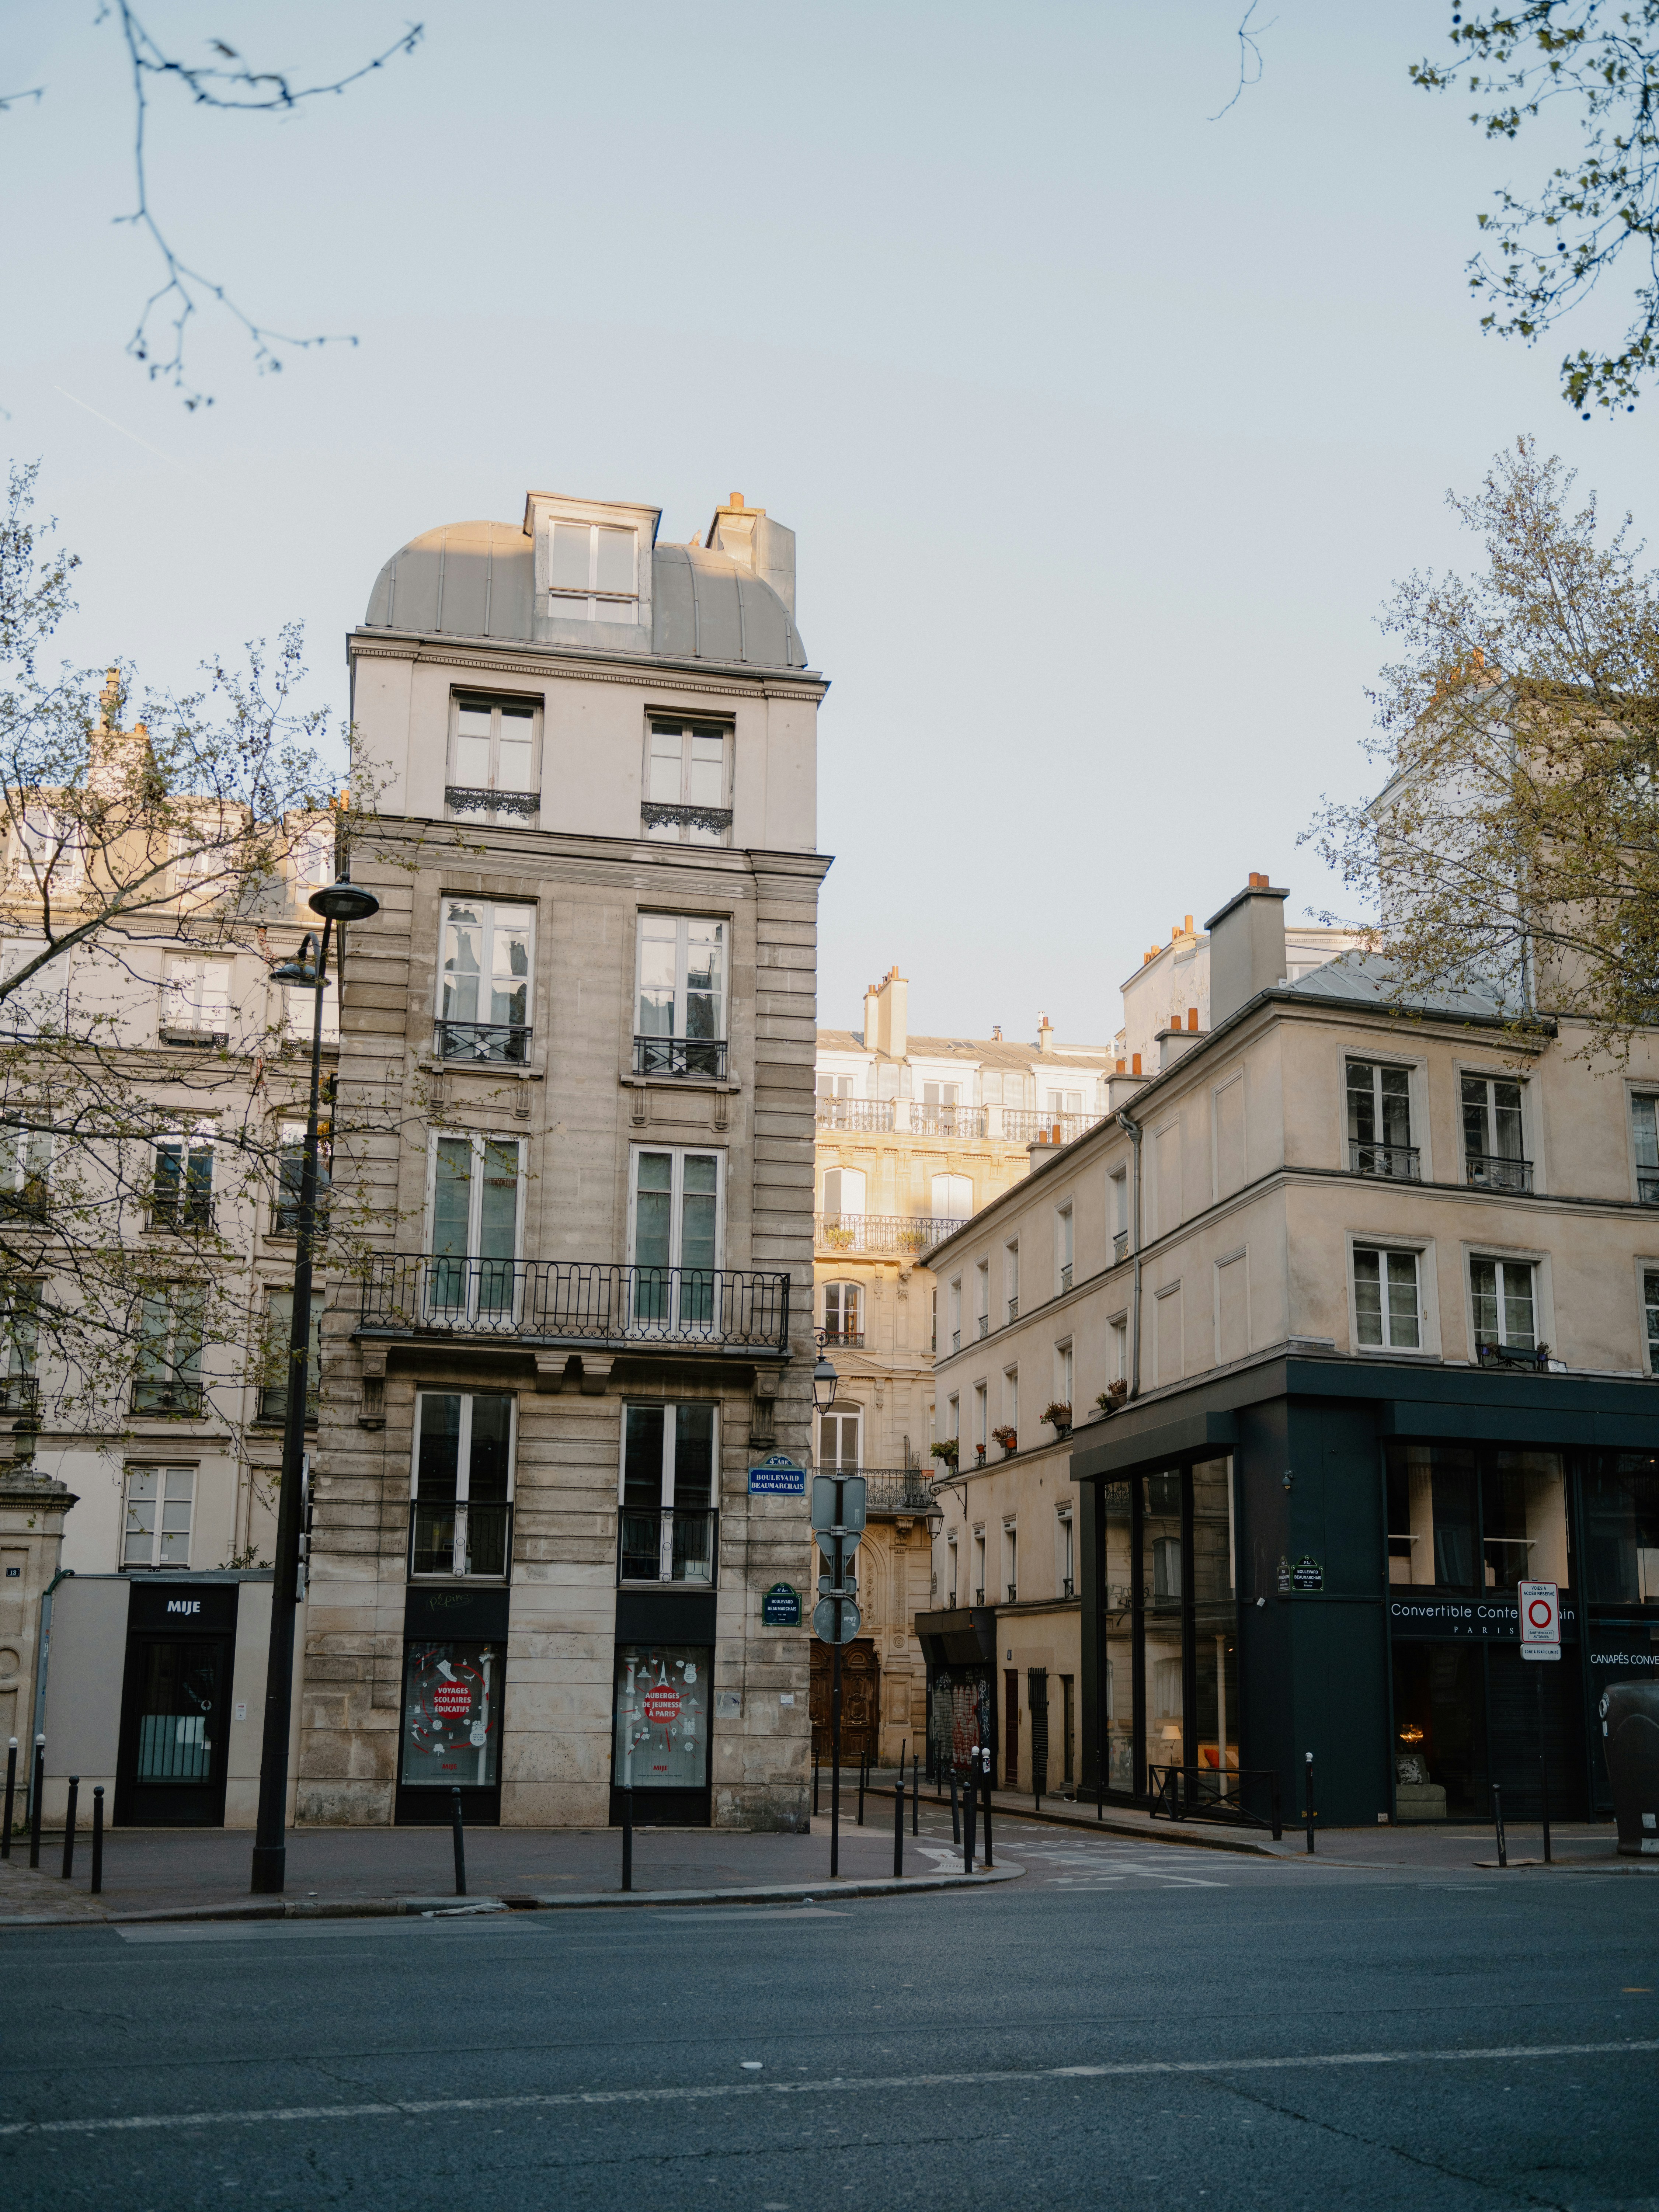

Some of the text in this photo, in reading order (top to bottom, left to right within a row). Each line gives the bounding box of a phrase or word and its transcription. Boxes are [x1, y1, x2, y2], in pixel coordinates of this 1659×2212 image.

[167, 1600, 201, 1615] MIJE
[1391, 1603, 1472, 1618] Convertible
[1590, 1652, 1629, 1664] CANAPÉS
